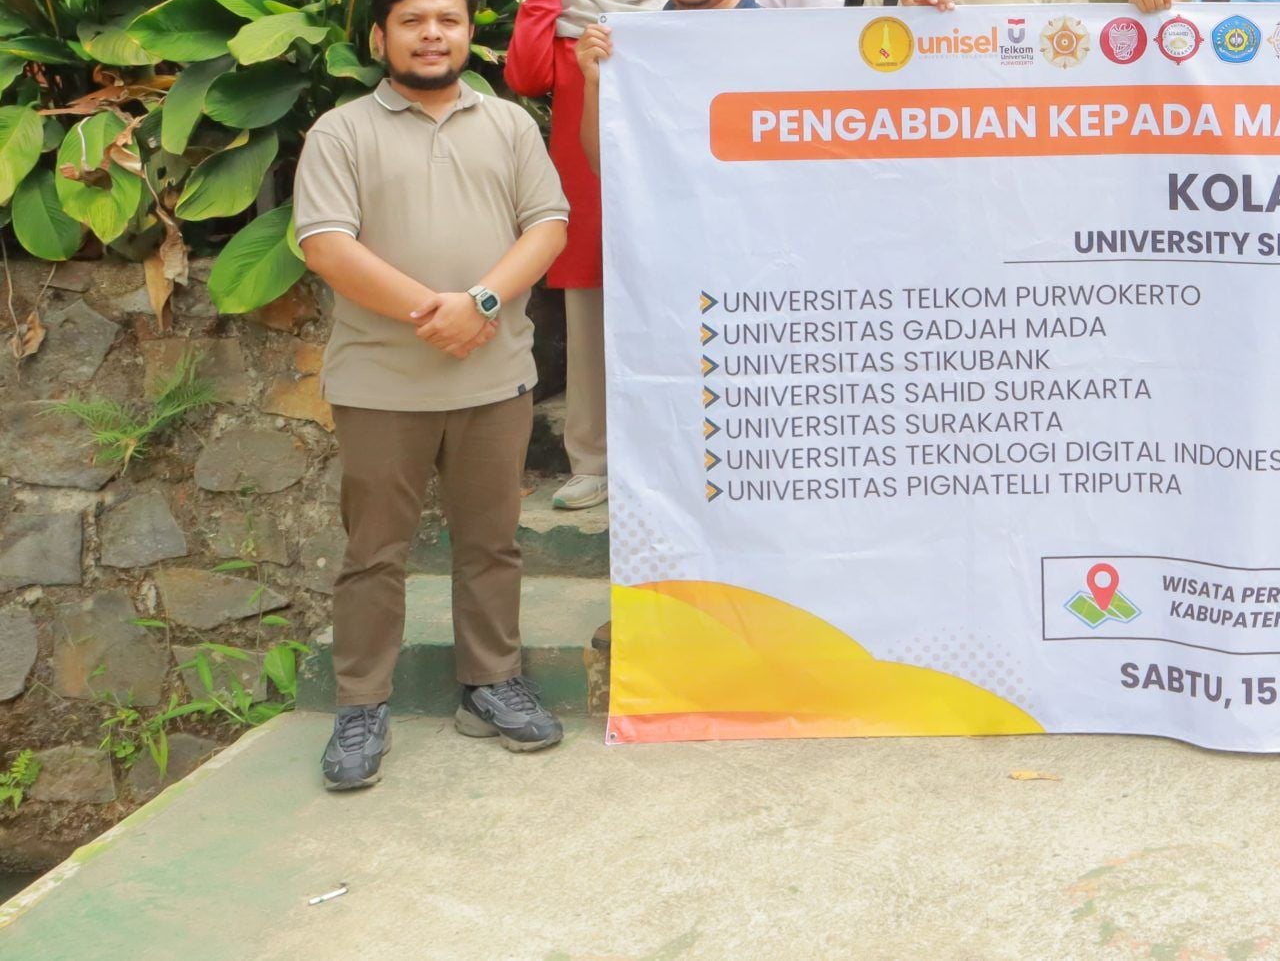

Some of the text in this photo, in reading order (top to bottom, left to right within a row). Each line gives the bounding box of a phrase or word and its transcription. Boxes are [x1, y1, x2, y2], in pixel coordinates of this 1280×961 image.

[917, 26, 998, 55] unisel
[999, 45, 1034, 54] Telkom
[751, 106, 1037, 142] PENGABDIAN
[1048, 104, 1223, 137] KEPADA
[1074, 230, 1251, 255] UNIVERSITY
[723, 284, 1201, 312] UNIVERSITAS TELKOM PURWOKERTO
[723, 316, 1107, 344] UNIVERSITAS GADJAH MADA
[724, 349, 1051, 376] UNIVERSITAS STIKUBANK
[724, 378, 1152, 407] UNIVERSITAS SAHID SURAKARTA
[725, 411, 1064, 439] UNIVERSITAS SURAKARTA
[726, 446, 897, 470] UNIVERSITAS
[905, 443, 1056, 465] TEKNOLOGI
[1065, 441, 1166, 462] DIGITAL
[727, 473, 1182, 500] UNIVERSITAS PIGNATELLI TRIPUTRA
[1162, 575, 1235, 602] WISATA
[1120, 662, 1232, 709] SABTU,
[1241, 677, 1278, 705] 15
